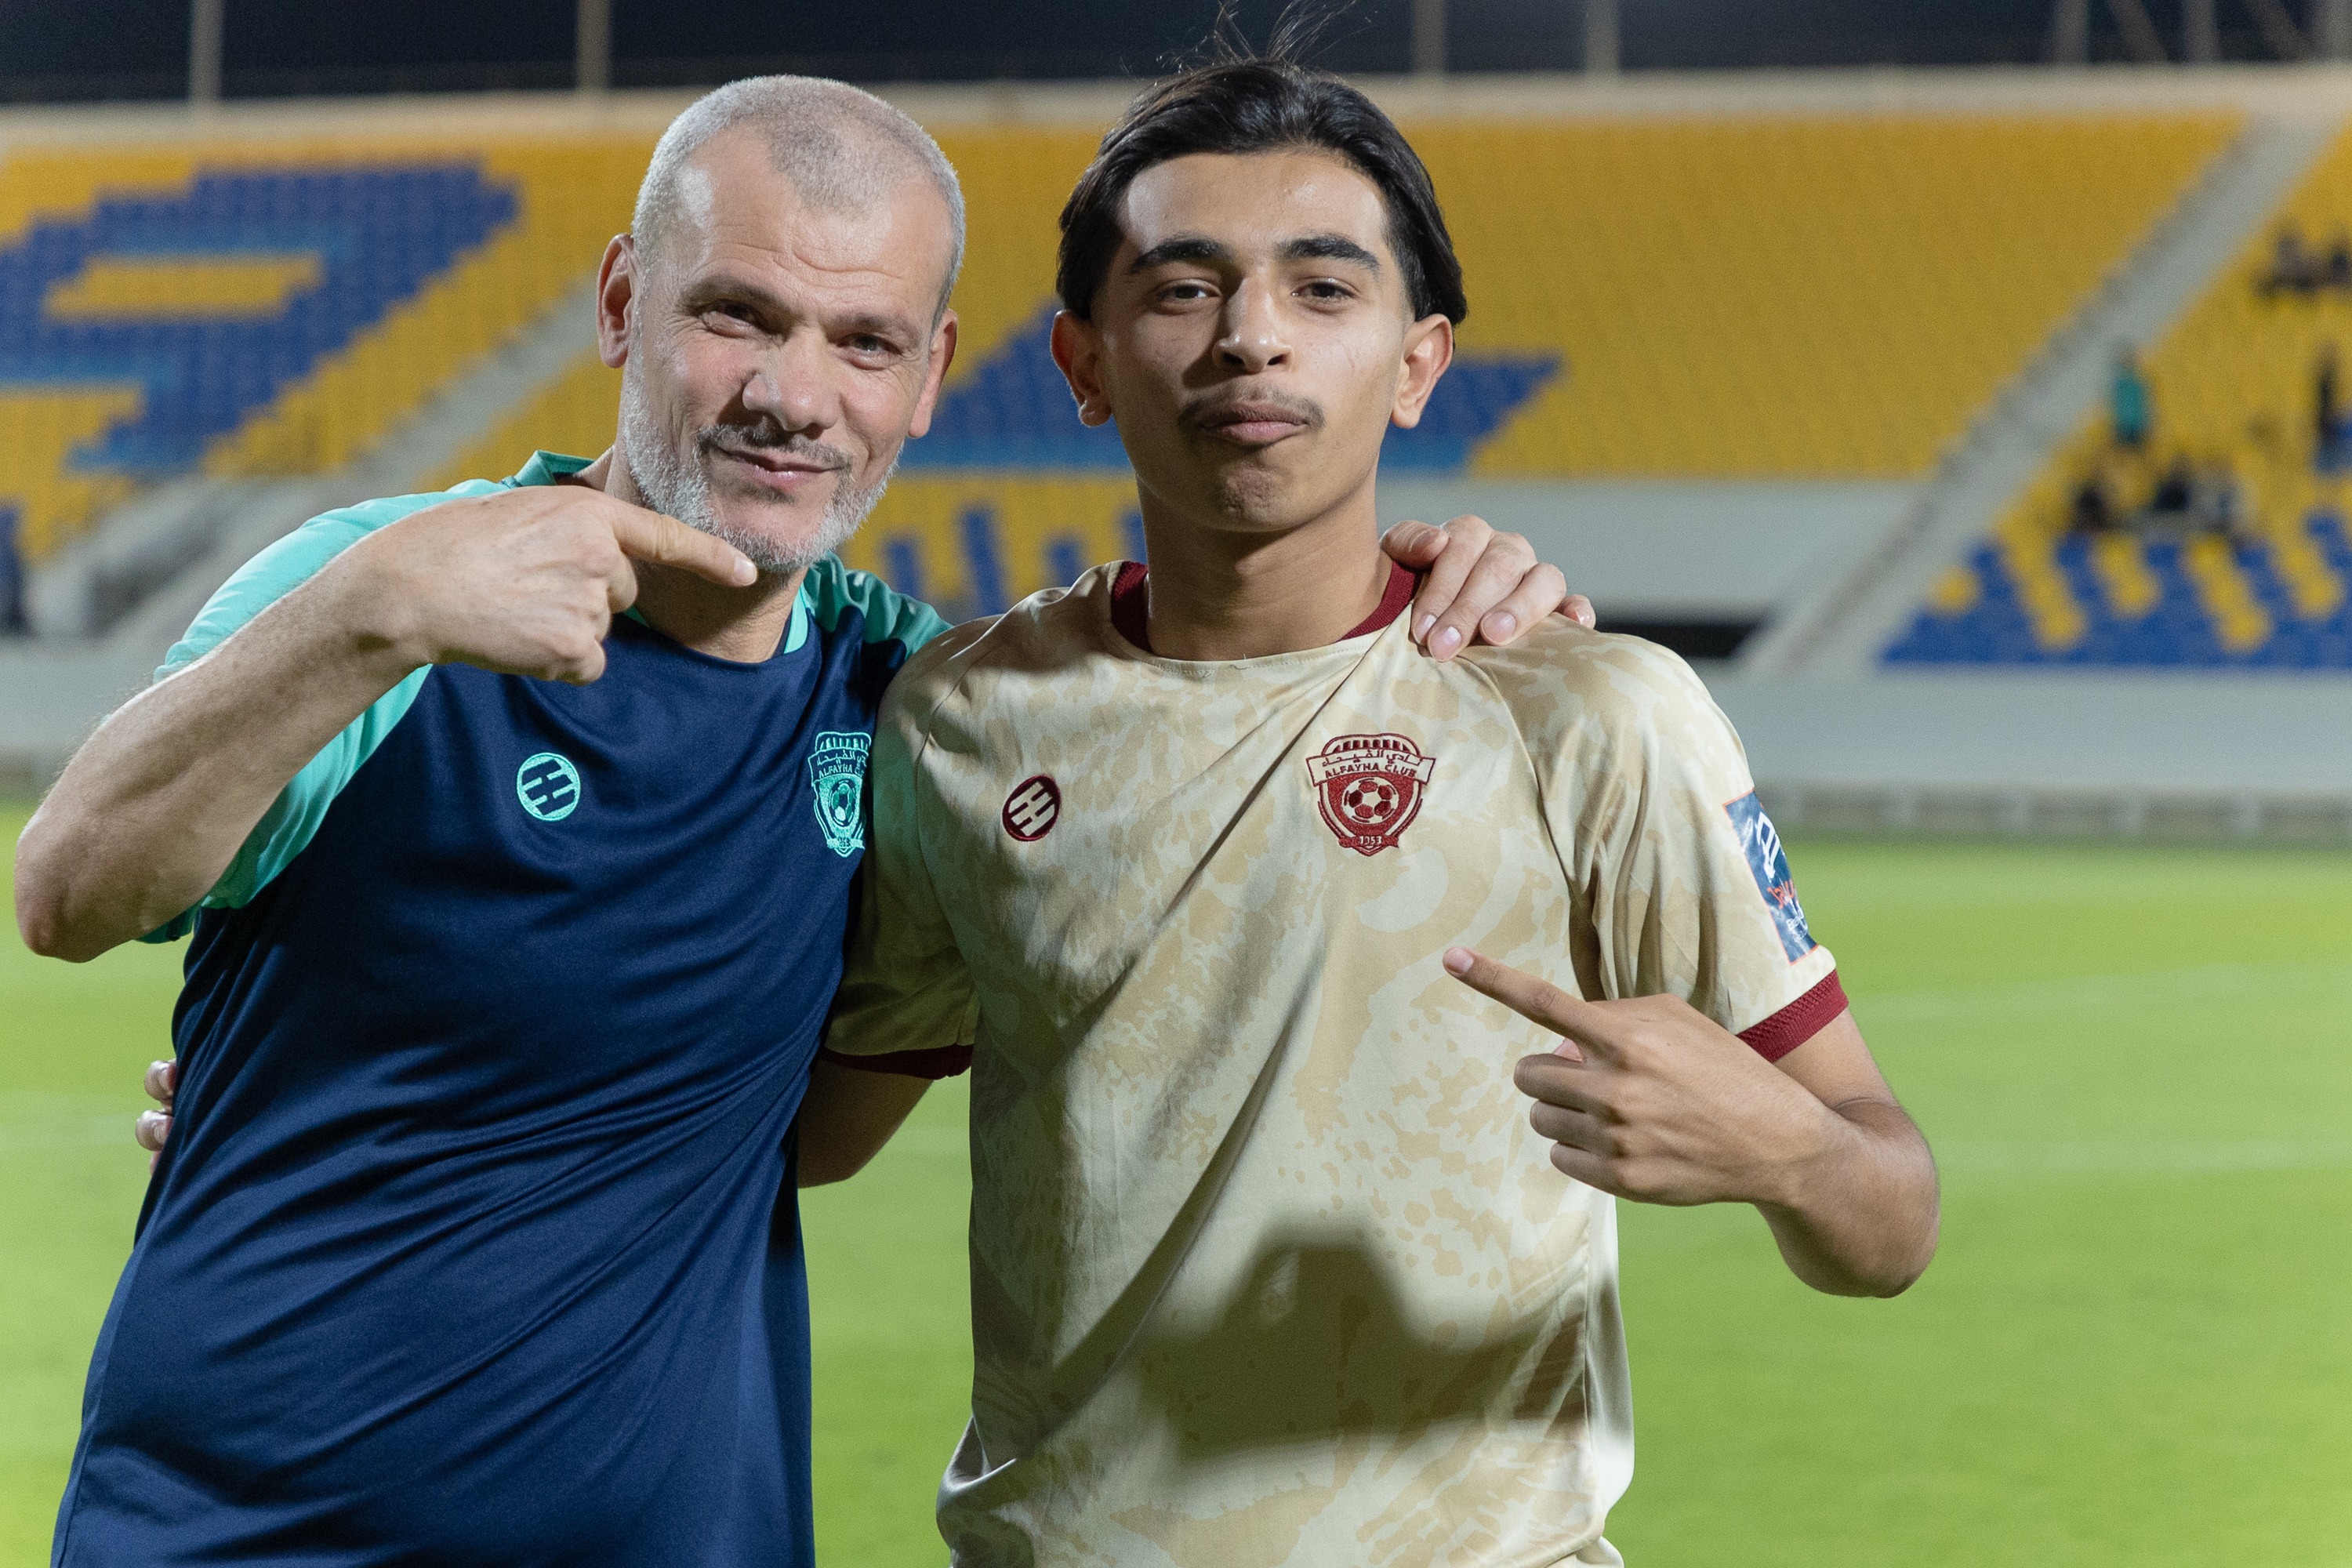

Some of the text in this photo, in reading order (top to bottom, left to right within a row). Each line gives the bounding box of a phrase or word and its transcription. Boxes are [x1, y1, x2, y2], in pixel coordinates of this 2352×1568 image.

[1322, 749, 1384, 767] الفيحاء
[818, 764, 852, 779] ALFAYHA
[1325, 763, 1417, 779] ALFAYHA CLUB
[1359, 836, 1382, 844] 1953
